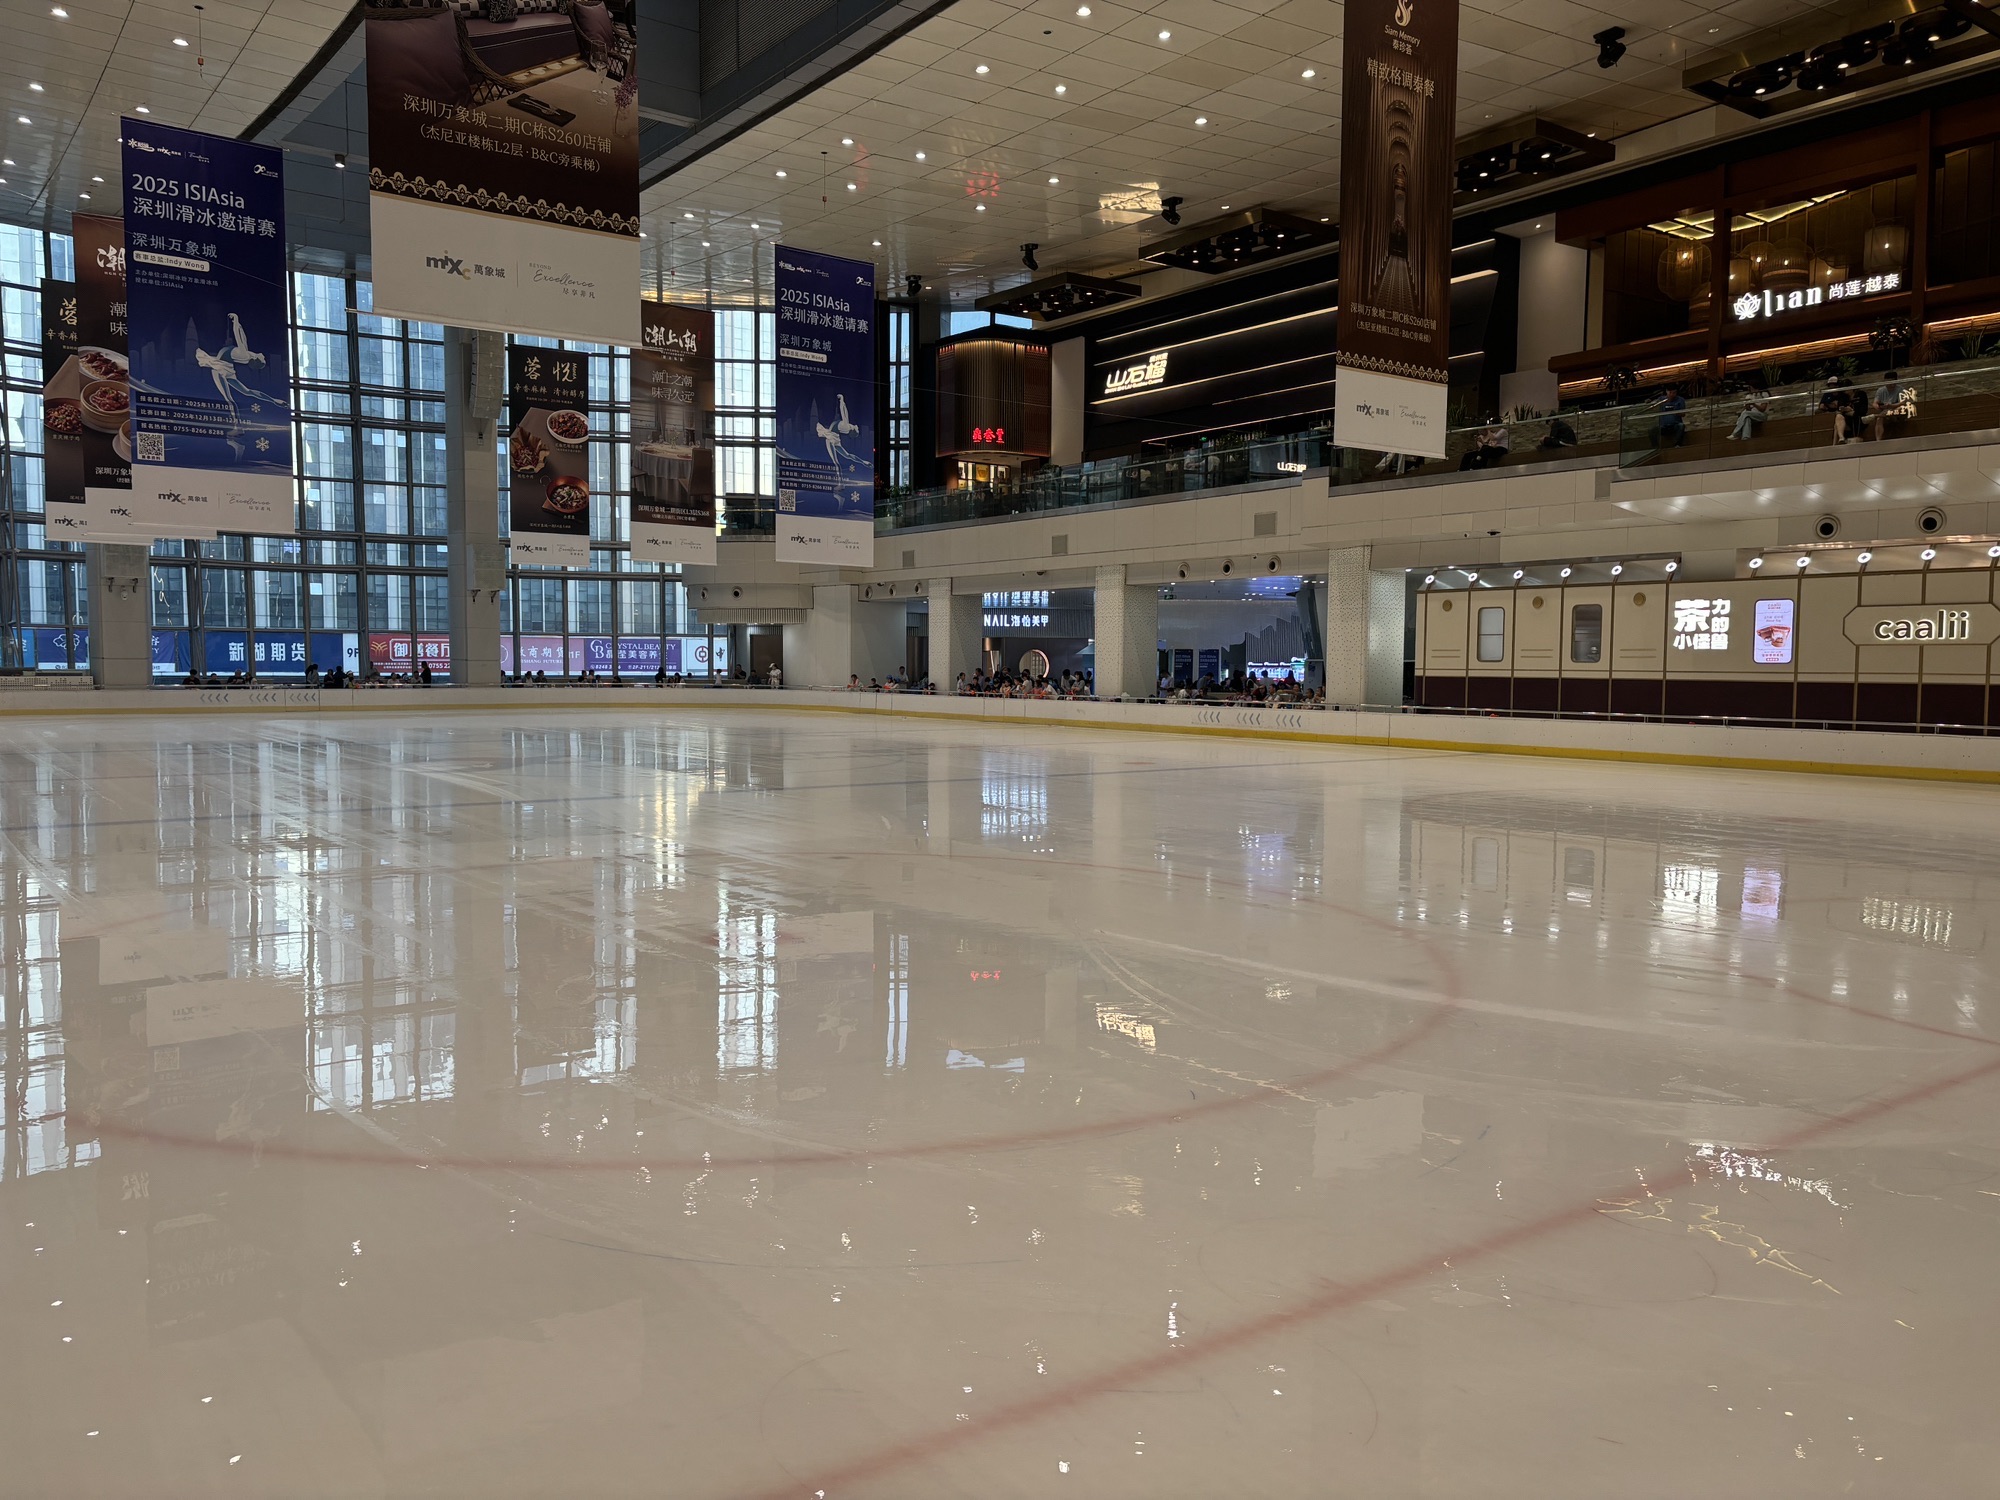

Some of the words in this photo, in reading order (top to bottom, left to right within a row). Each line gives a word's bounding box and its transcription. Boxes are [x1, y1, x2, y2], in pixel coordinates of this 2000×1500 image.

[1384, 24, 1398, 38] Siam
[1399, 29, 1421, 47] Memory
[402, 93, 612, 155] 深圳万象城二期C栋S260店铺
[132, 173, 180, 197] 2025
[184, 182, 245, 209] ISIAsia
[132, 196, 277, 238] 深圳滑冰邀请赛
[132, 232, 218, 258] 深圳万象城
[184, 260, 206, 270] Wong
[474, 264, 506, 279] 萬象城
[533, 269, 595, 288] Excellence
[780, 288, 810, 305] 2025
[813, 293, 850, 312] ISIAsia
[1762, 286, 1823, 318] lian
[110, 321, 128, 337] 味
[781, 305, 869, 334] 深圳滑冰邀请赛
[779, 333, 832, 352] 深圳万象城
[1106, 360, 1167, 389] 山石榴
[983, 614, 1010, 627] NAIL
[1873, 609, 1970, 641] caalii
[605, 642, 643, 650] CYSTAL
[1673, 633, 1729, 651] 小怪兽
